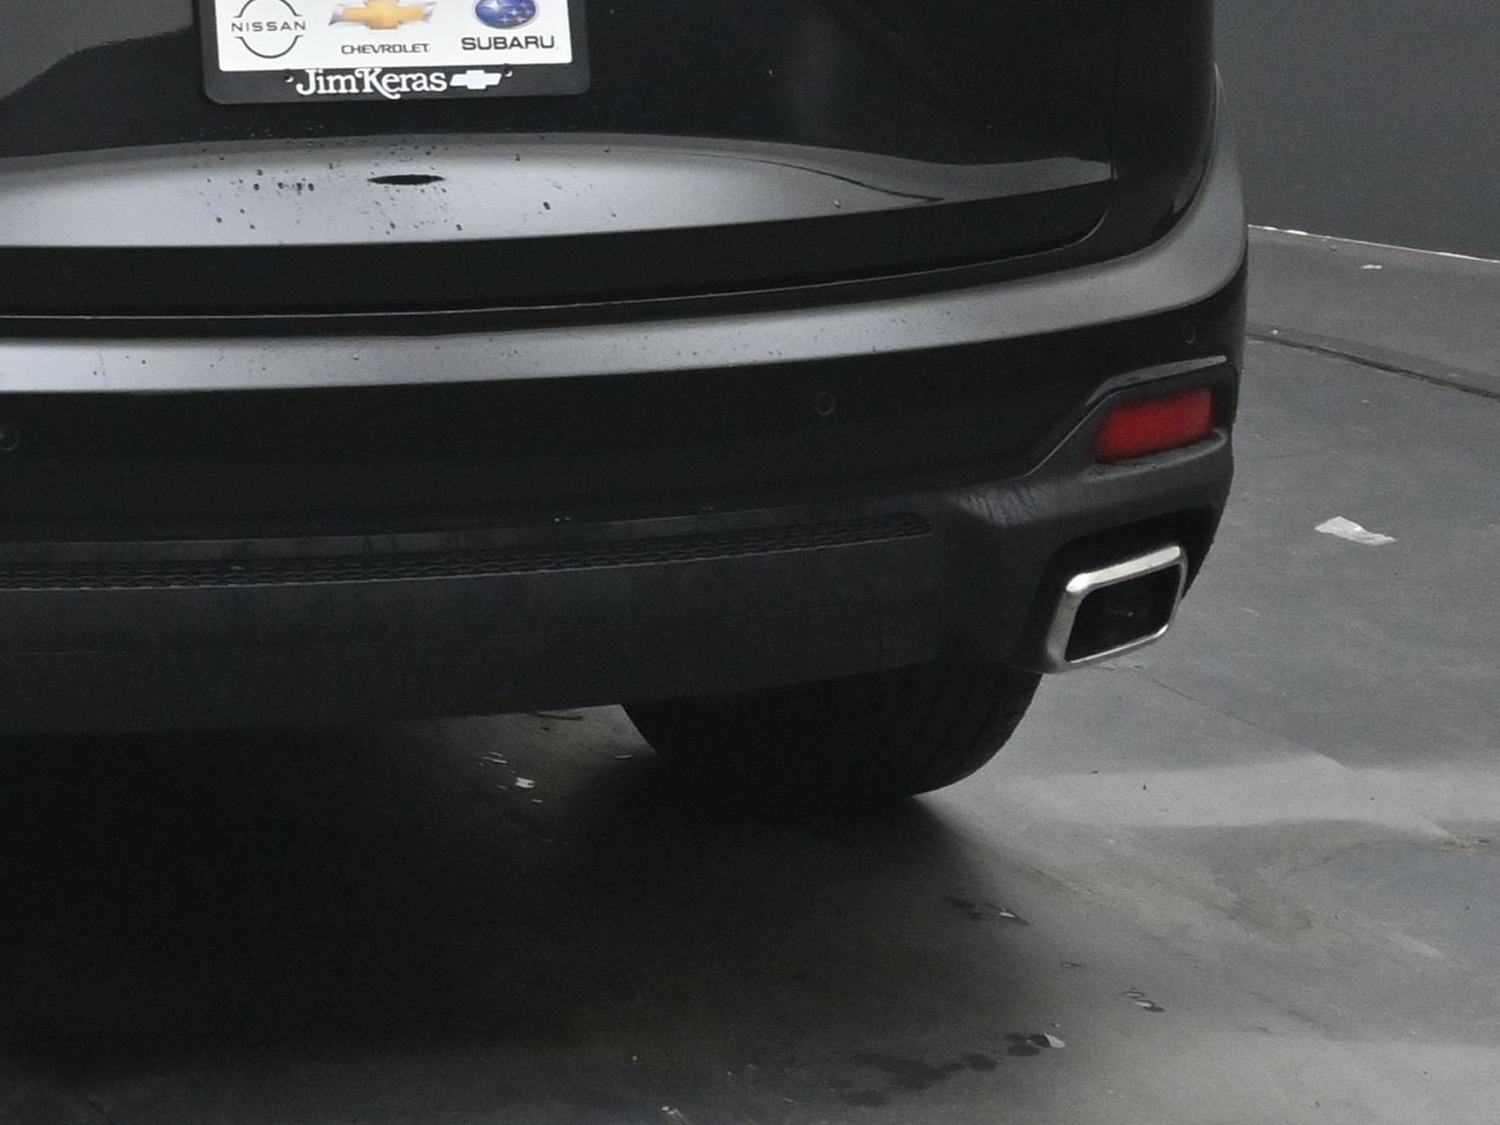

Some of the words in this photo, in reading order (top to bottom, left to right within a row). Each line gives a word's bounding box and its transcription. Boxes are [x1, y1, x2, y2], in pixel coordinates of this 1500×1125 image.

[231, 19, 306, 32] NISSAN
[341, 43, 429, 54] CHEVROLET
[461, 35, 555, 51] SUBARU
